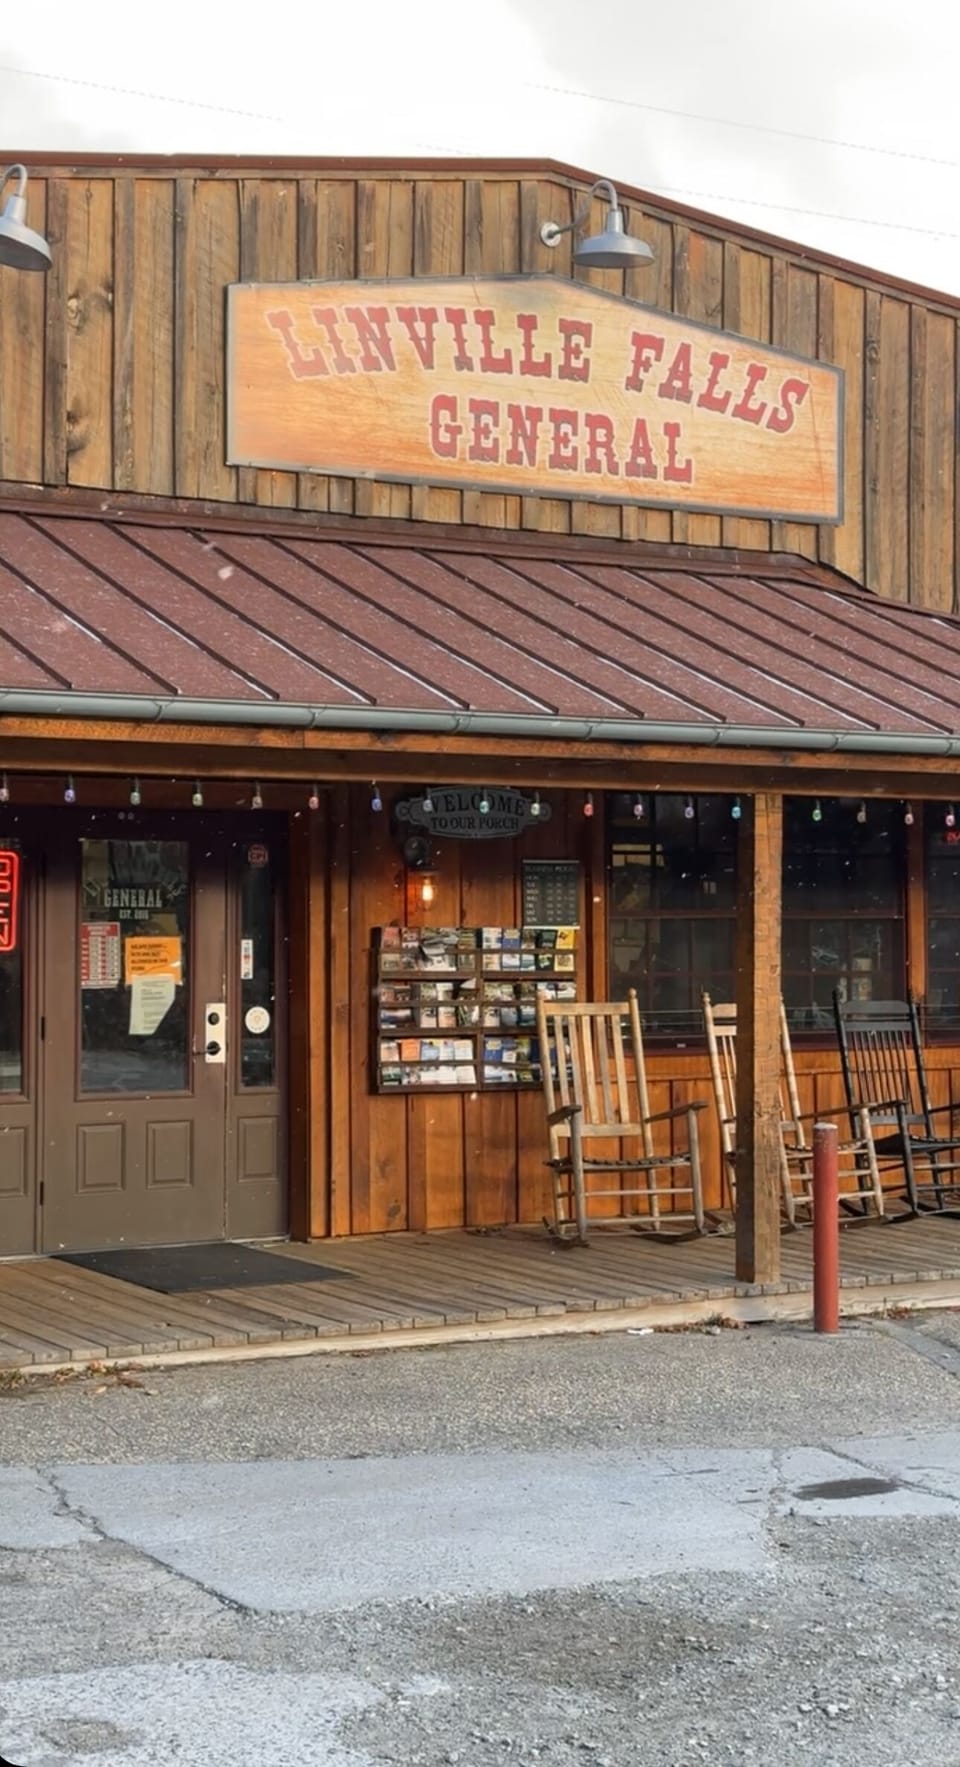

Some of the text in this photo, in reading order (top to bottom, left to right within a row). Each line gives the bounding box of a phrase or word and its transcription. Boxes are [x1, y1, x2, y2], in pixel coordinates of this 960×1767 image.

[267, 306, 810, 434] LINVILLE FALLS
[429, 394, 694, 484] GENERAL
[431, 818, 517, 830] TO OUR PORCH
[104, 888, 163, 908] GENERAL
